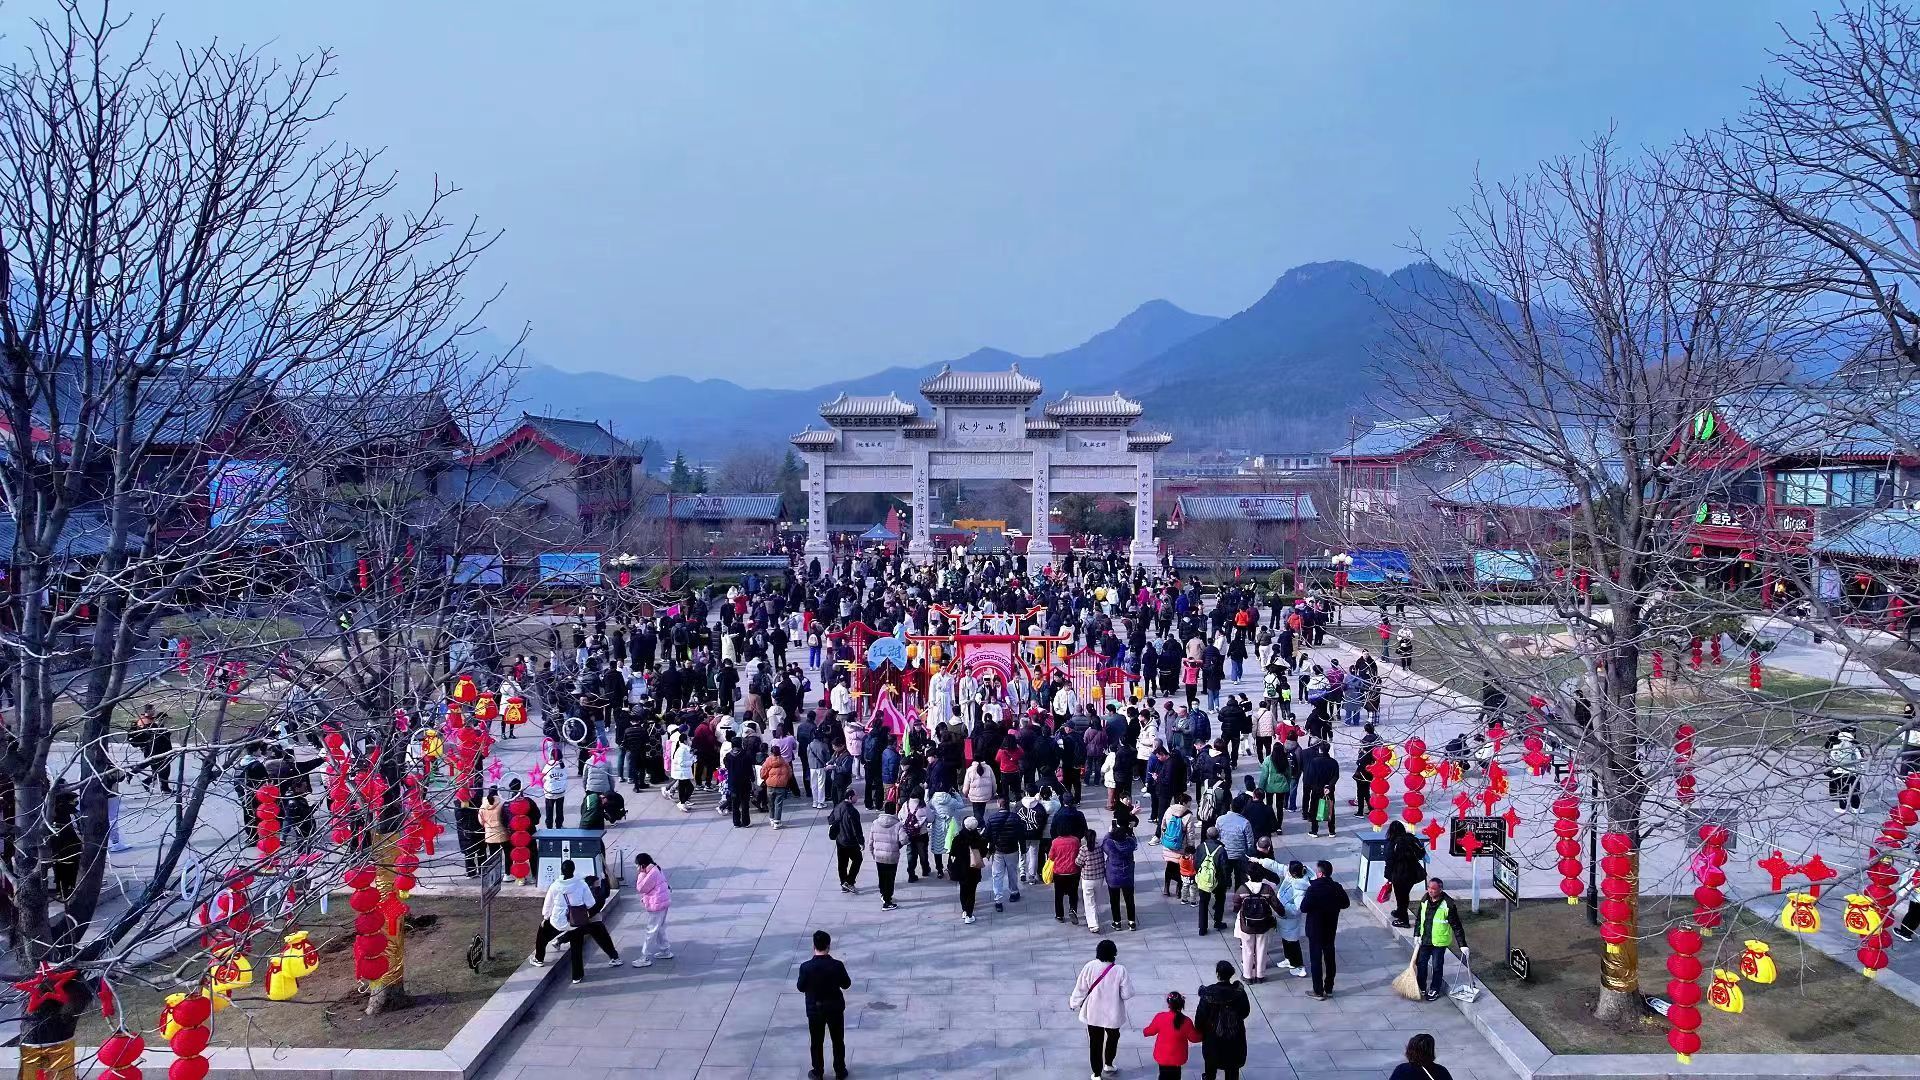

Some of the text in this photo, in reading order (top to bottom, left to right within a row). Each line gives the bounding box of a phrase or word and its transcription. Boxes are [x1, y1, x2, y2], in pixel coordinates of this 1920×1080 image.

[958, 421, 1007, 434] 嵩山少林
[872, 645, 902, 660] 江湖
